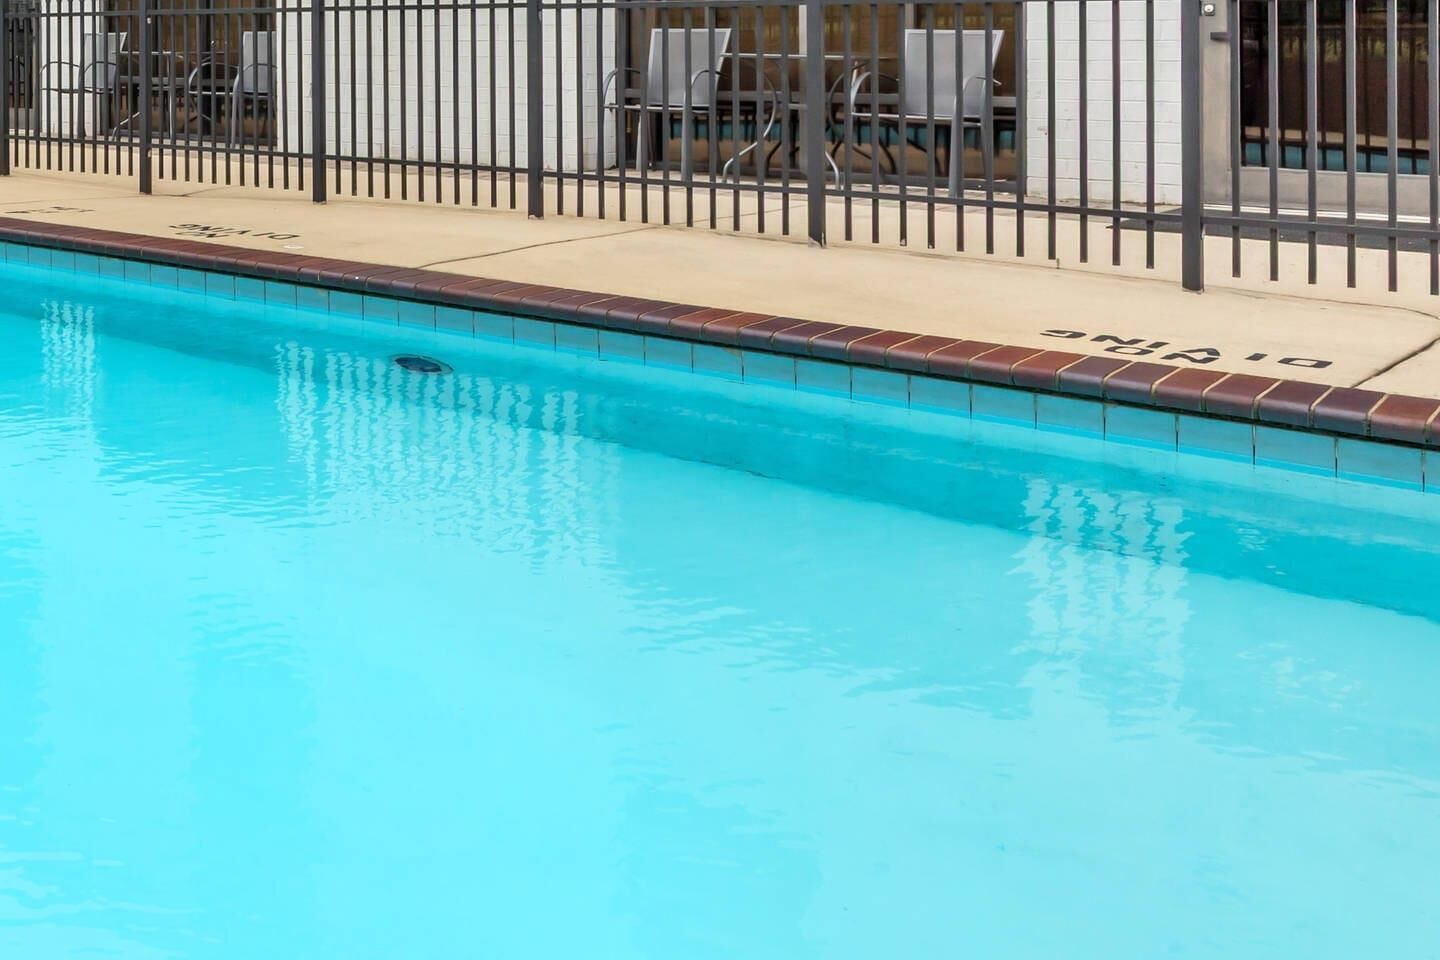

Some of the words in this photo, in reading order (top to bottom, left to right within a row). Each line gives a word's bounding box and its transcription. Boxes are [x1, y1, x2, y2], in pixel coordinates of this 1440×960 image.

[167, 223, 302, 241] DIVING
[1039, 328, 1334, 369] DIVING
[1104, 345, 1220, 364] NO
